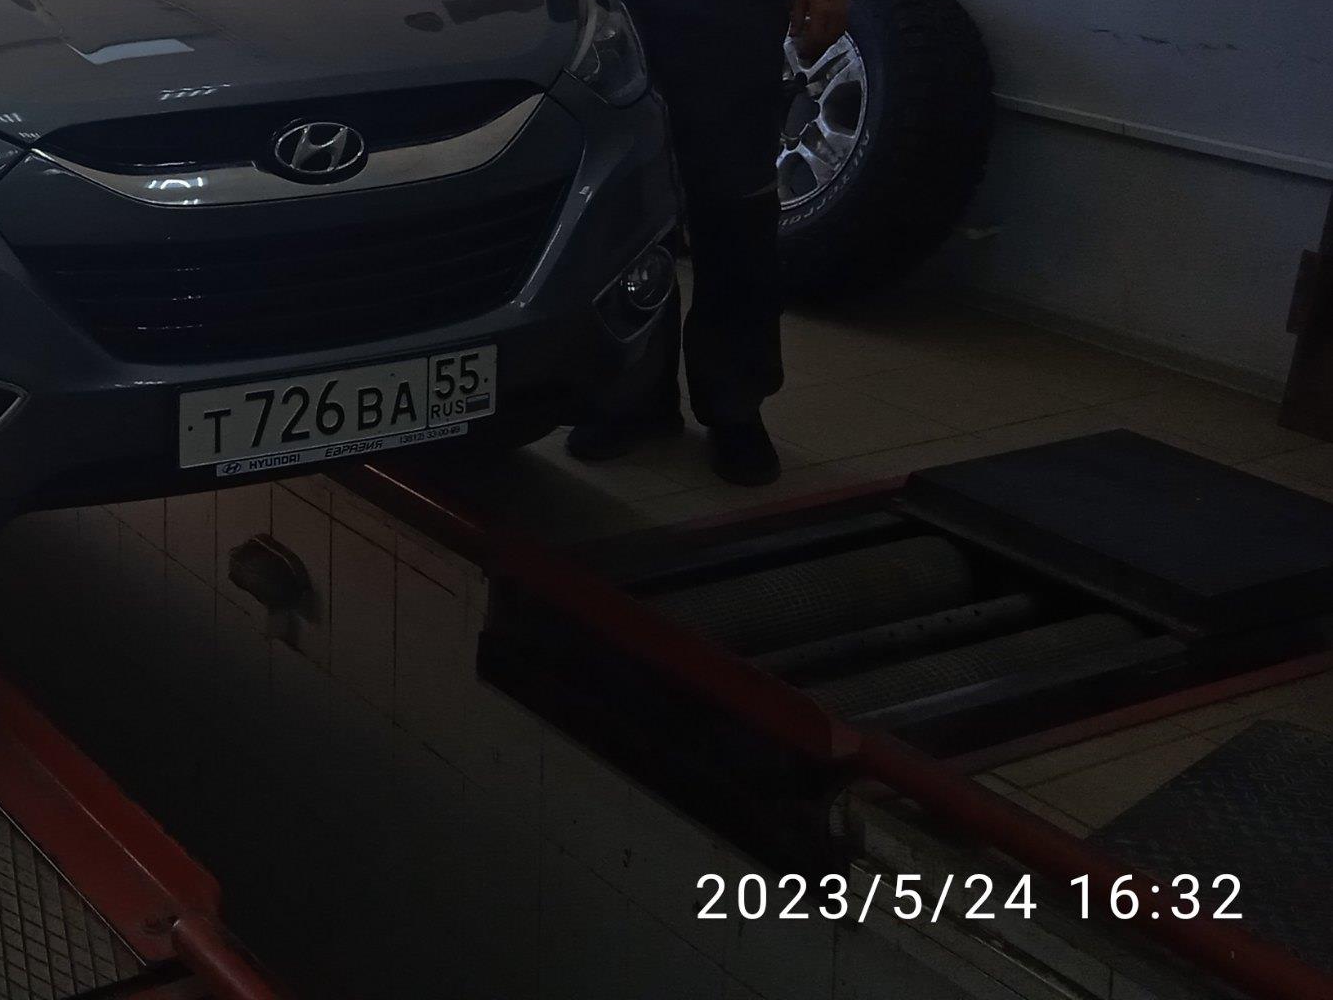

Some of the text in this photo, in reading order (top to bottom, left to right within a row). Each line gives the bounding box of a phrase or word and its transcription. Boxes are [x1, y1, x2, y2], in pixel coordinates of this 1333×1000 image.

[435, 353, 479, 400] 55
[431, 401, 465, 419] RUS
[324, 439, 384, 458] ЕВРАЗИЯ
